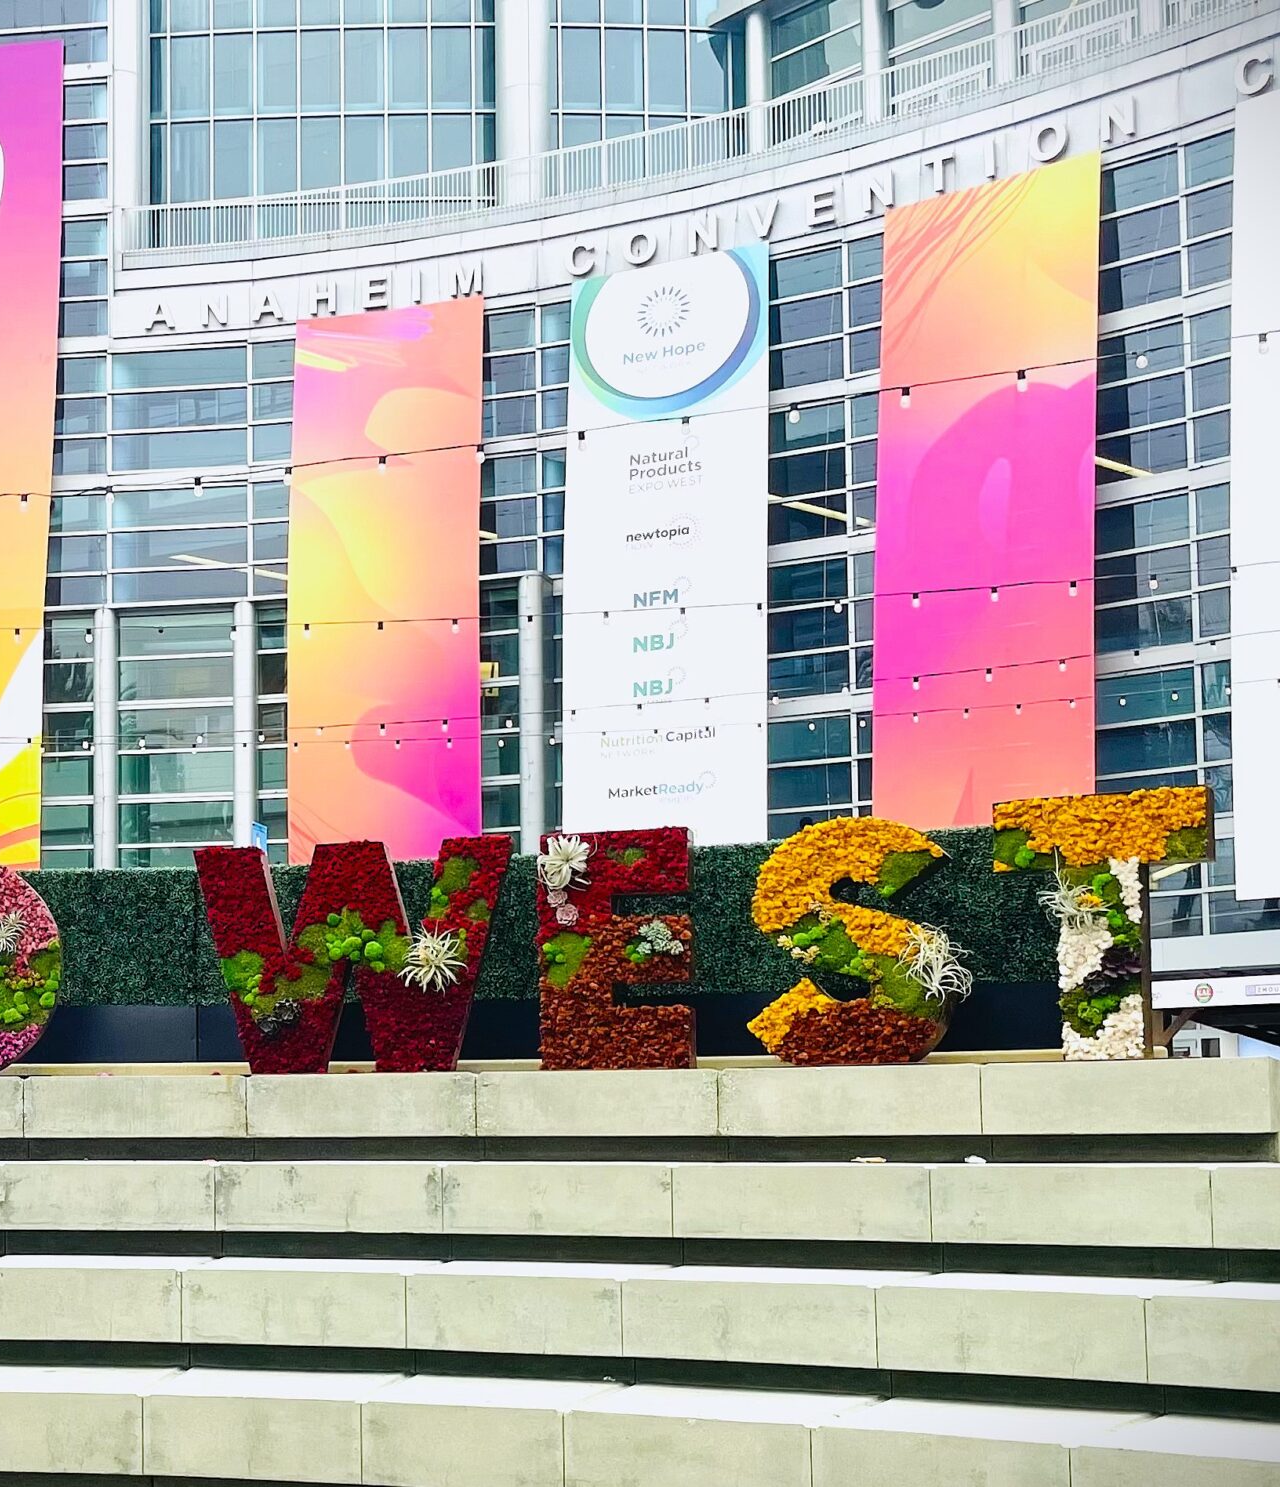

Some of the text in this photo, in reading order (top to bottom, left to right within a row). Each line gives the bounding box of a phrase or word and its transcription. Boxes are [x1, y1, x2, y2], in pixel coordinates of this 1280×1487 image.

[145, 257, 483, 331] ANAHEIM
[564, 96, 1137, 277] CONVENTION
[623, 341, 706, 365] New Hope
[629, 446, 688, 466] Natural
[629, 460, 702, 480] Products
[628, 475, 703, 494] EXPO WEST
[626, 525, 689, 542] newtopia
[633, 588, 679, 608] NFM
[633, 632, 675, 653] NBJ
[633, 678, 673, 698] NBJ
[600, 726, 715, 748] Nutrition Capital
[608, 779, 704, 799] MarketReady
[193, 785, 1216, 1076] WEST
